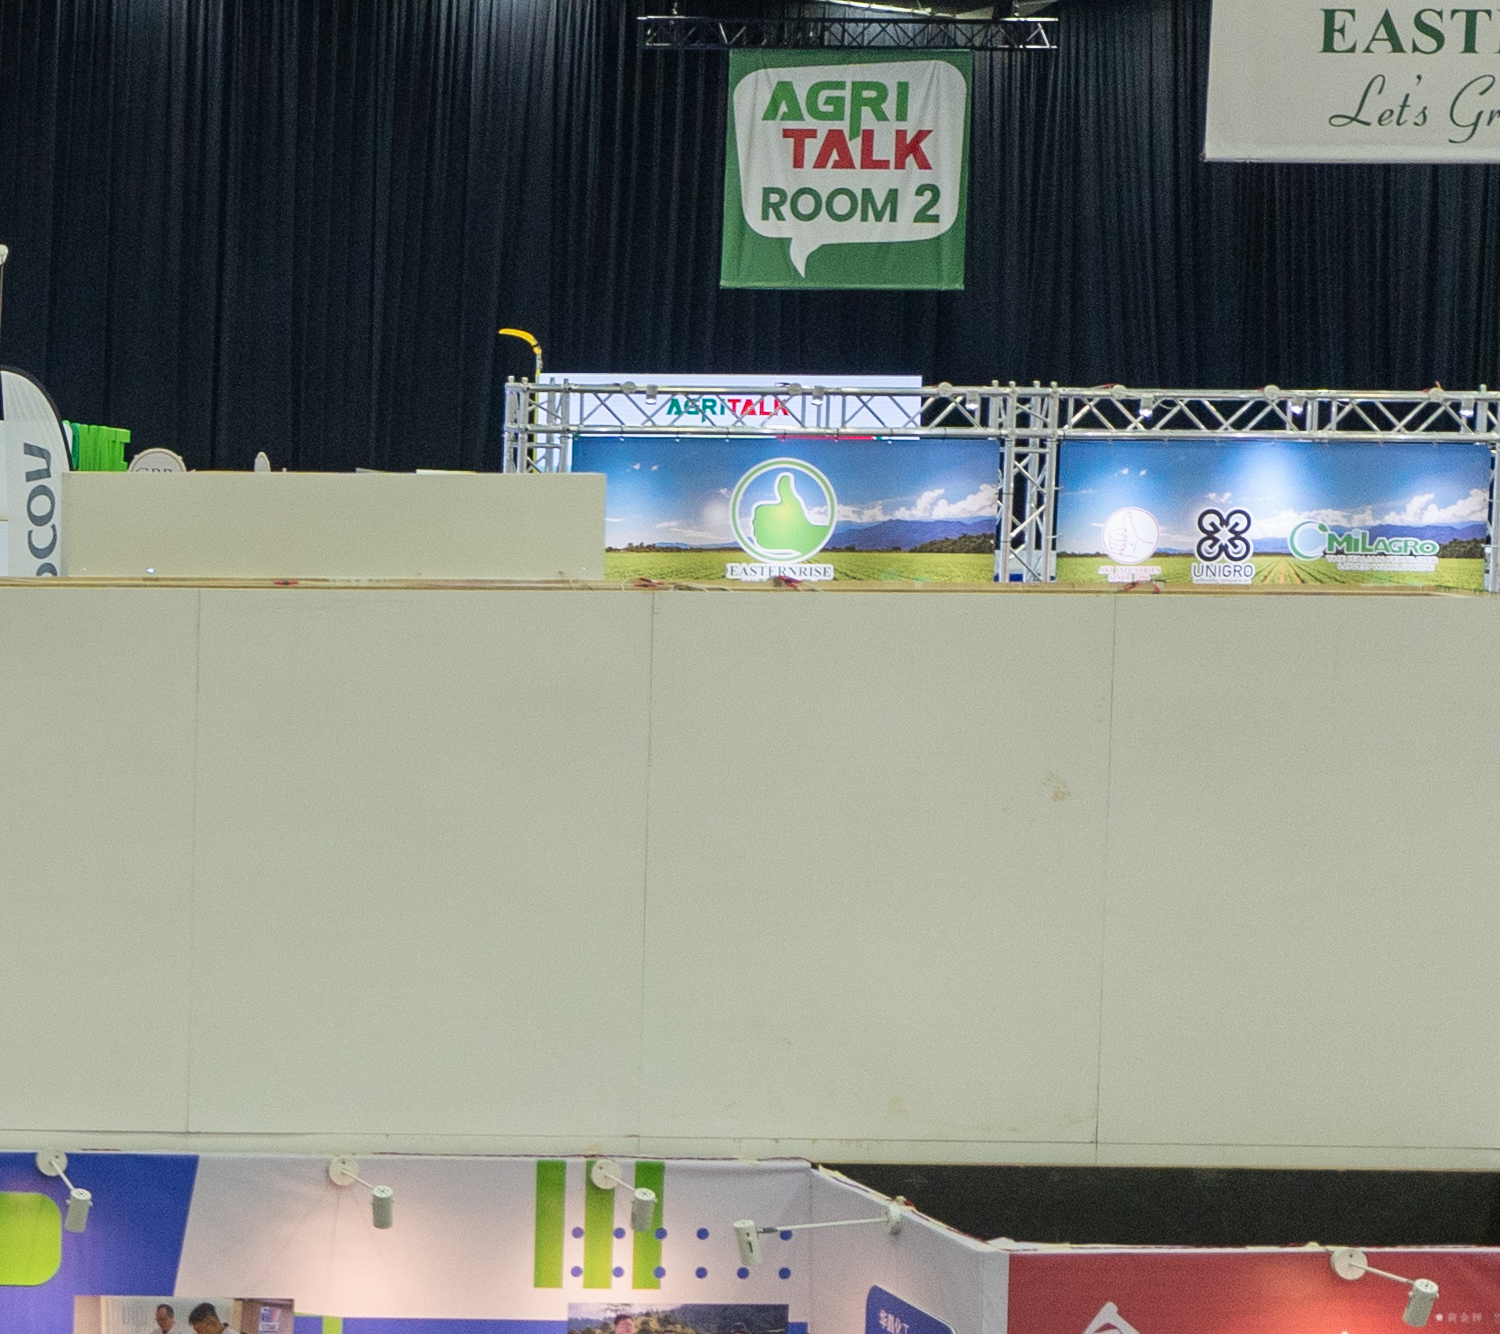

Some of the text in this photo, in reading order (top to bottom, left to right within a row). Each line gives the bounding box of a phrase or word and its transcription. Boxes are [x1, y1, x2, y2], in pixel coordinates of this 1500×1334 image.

[1319, 7, 1500, 55] EAST
[762, 80, 908, 144] AGRI
[783, 129, 933, 170] TALK
[761, 183, 940, 224] ROOM 2
[729, 565, 832, 578] EASTERNRISE
[1193, 564, 1253, 578] UNIGRO
